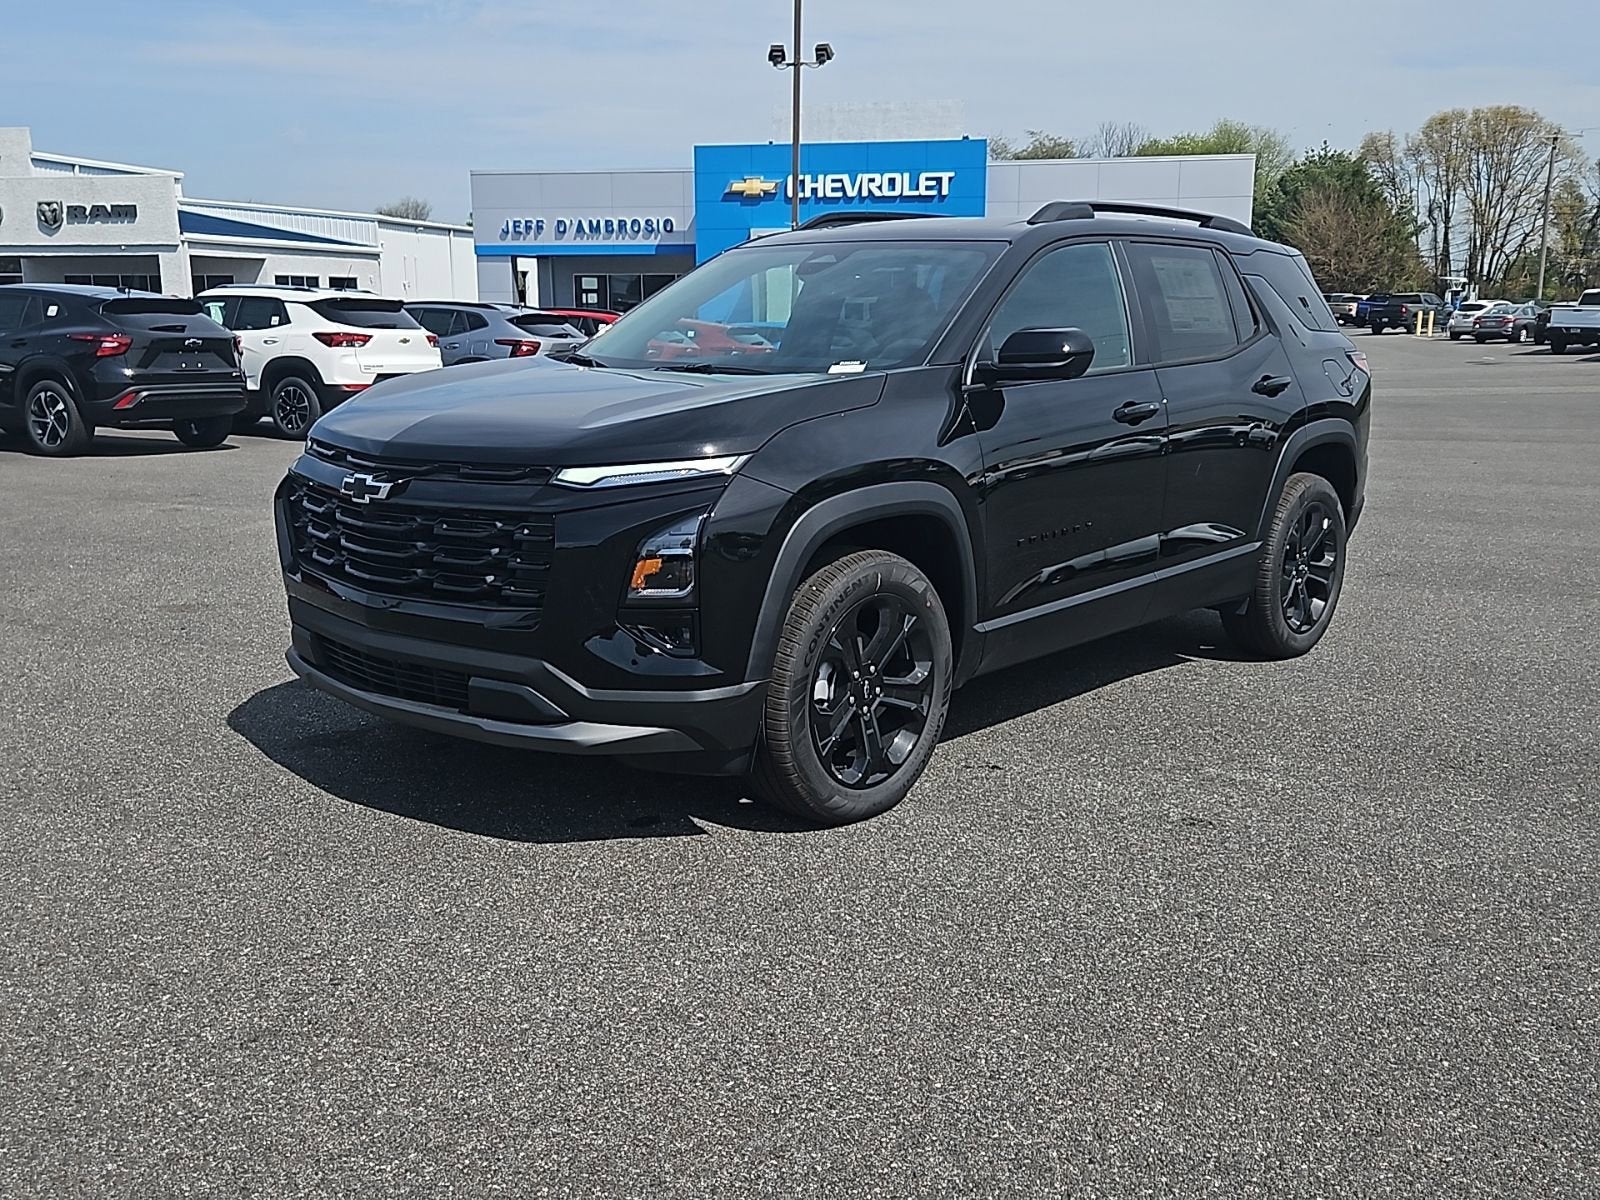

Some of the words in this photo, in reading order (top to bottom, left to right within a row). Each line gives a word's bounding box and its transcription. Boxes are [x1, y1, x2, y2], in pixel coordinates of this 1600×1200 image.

[787, 171, 955, 198] CHEVROLET
[66, 204, 137, 223] RAM
[501, 219, 545, 235] JEFF
[556, 218, 674, 234] D'AMBROSIO
